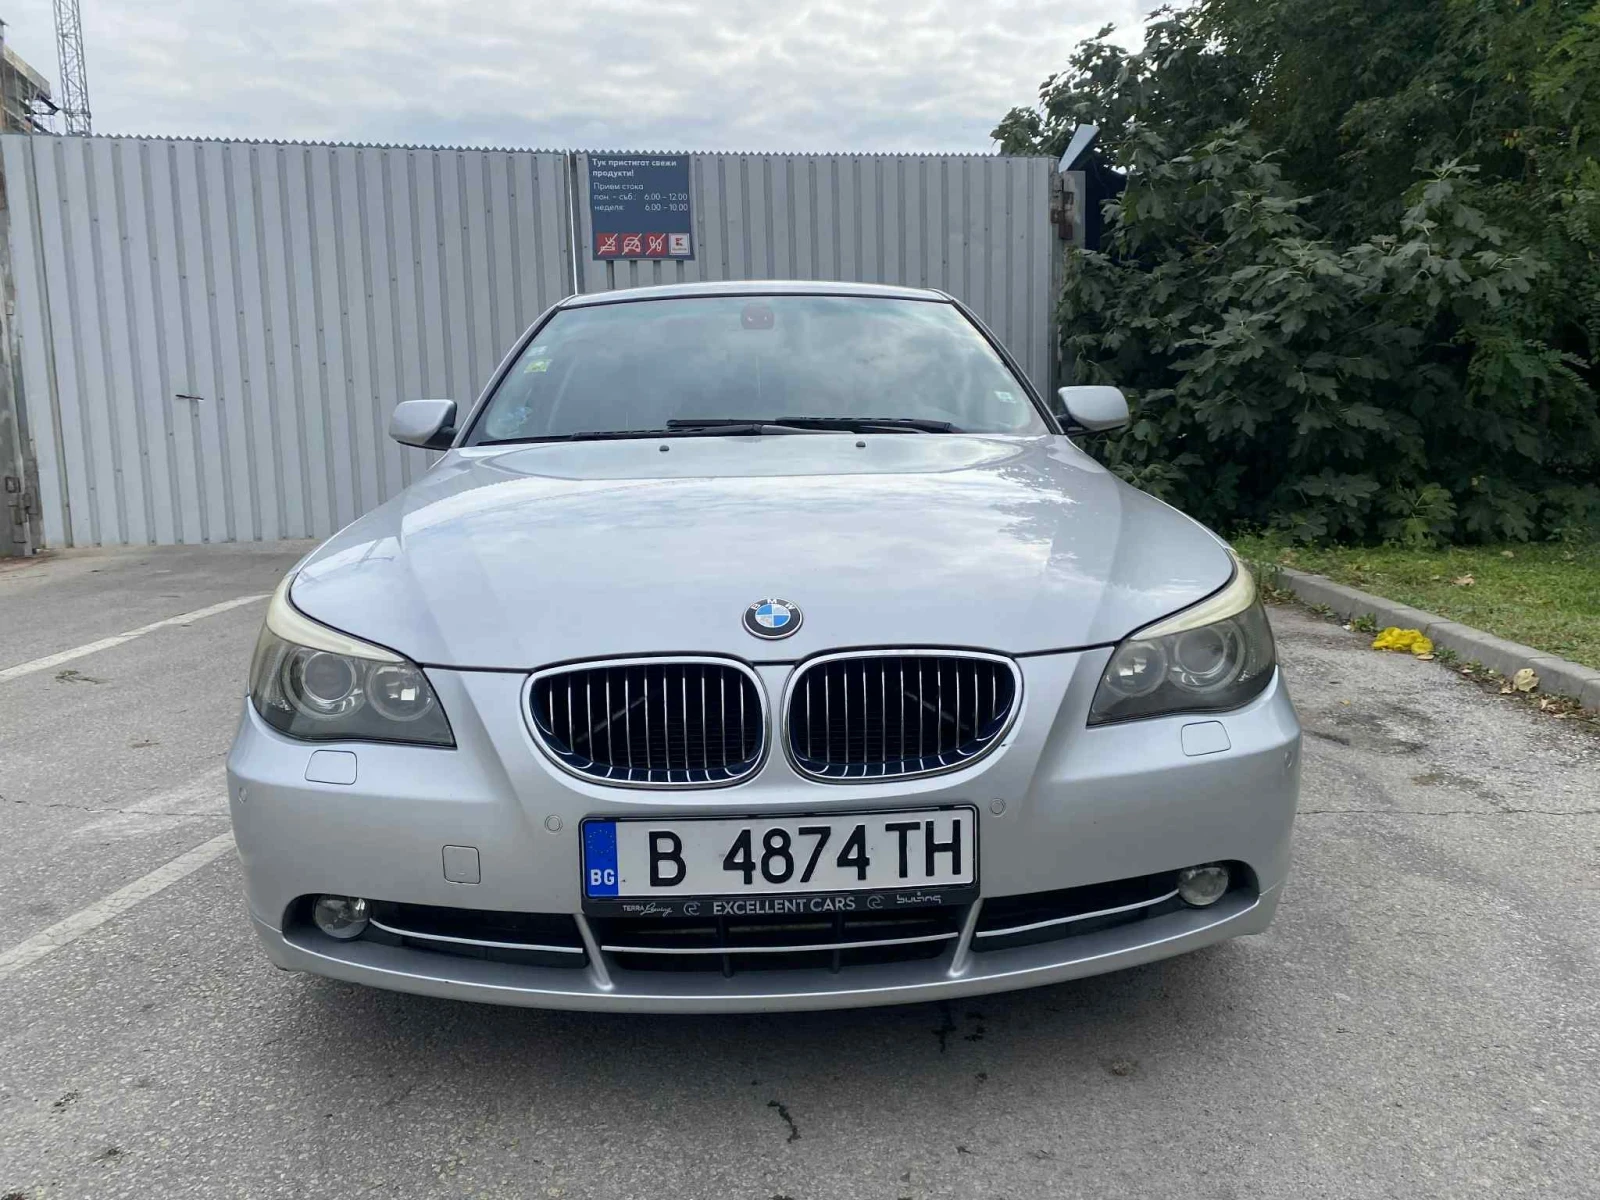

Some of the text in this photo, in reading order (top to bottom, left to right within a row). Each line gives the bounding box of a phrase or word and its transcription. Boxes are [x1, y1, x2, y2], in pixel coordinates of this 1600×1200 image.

[592, 158, 606, 167] Тук
[608, 159, 650, 167] пристигат
[592, 169, 634, 177] продукти!
[593, 182, 620, 190] Прием
[644, 193, 661, 201] 6.00
[669, 193, 688, 201] 12.00
[644, 203, 661, 211] 6.00
[670, 203, 689, 211] 10.00
[750, 598, 796, 610] BMW
[648, 819, 961, 887] B 4874 TH
[590, 869, 615, 886] BG
[713, 897, 856, 915] EXCELLENT CARS
